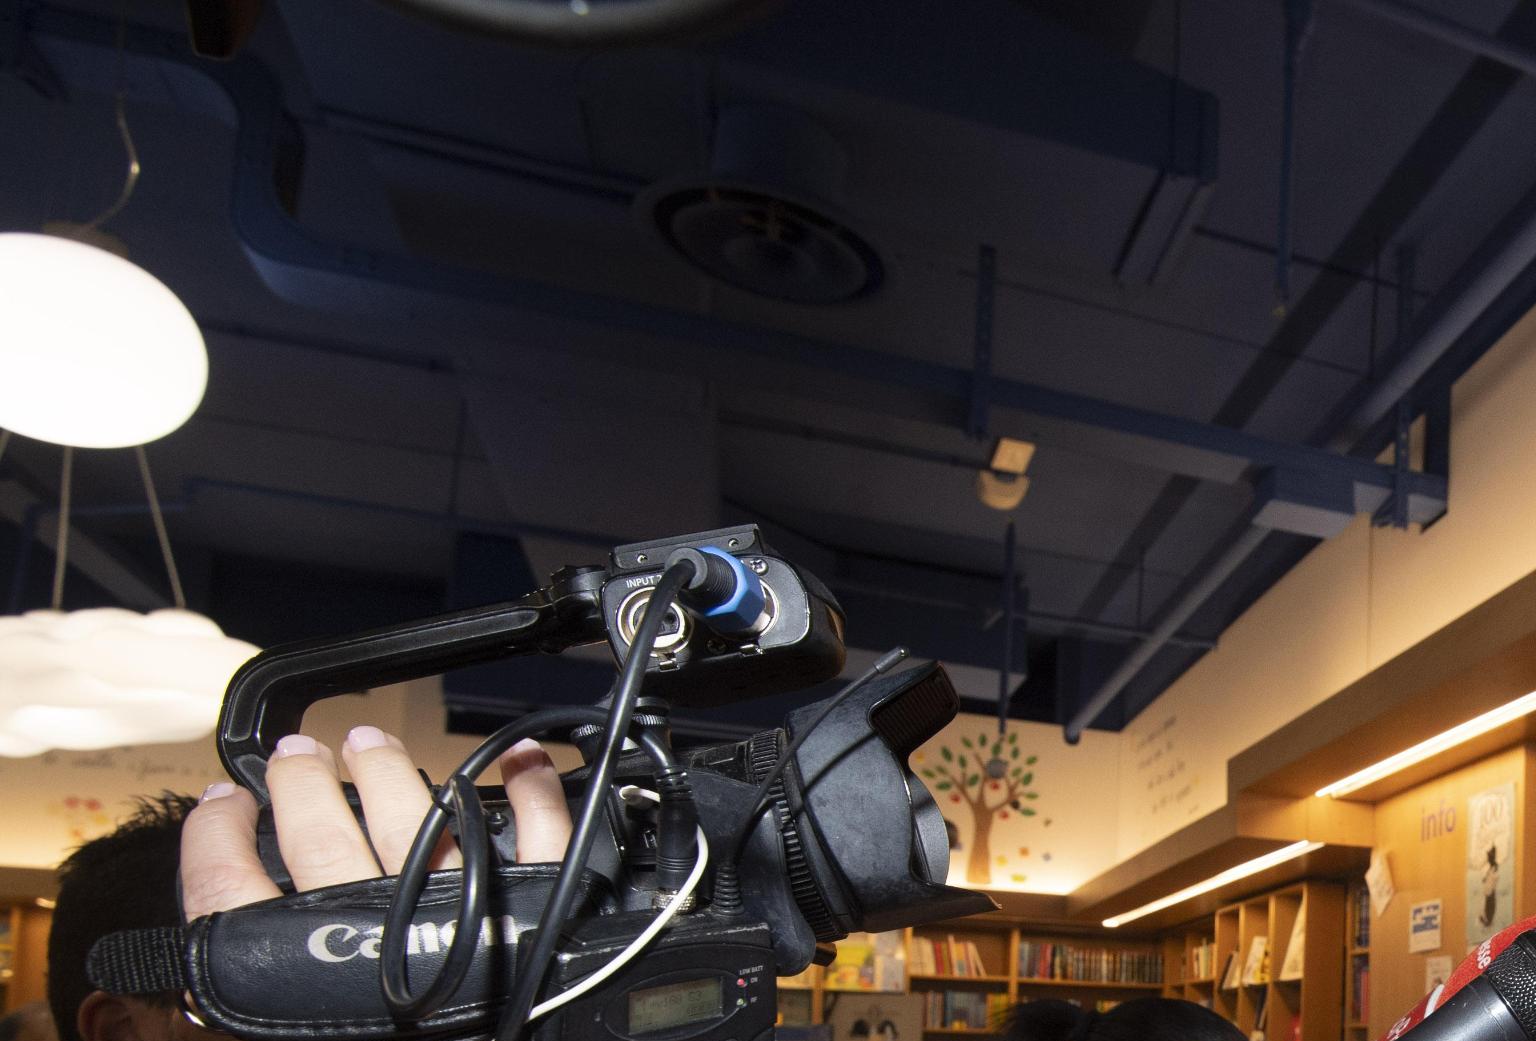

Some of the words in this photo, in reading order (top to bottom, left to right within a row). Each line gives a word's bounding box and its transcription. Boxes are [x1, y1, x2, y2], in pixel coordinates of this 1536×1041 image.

[625, 575, 654, 588] INPUT
[1421, 802, 1457, 842] info
[739, 968, 751, 976] LOW
[752, 965, 764, 974] BATT
